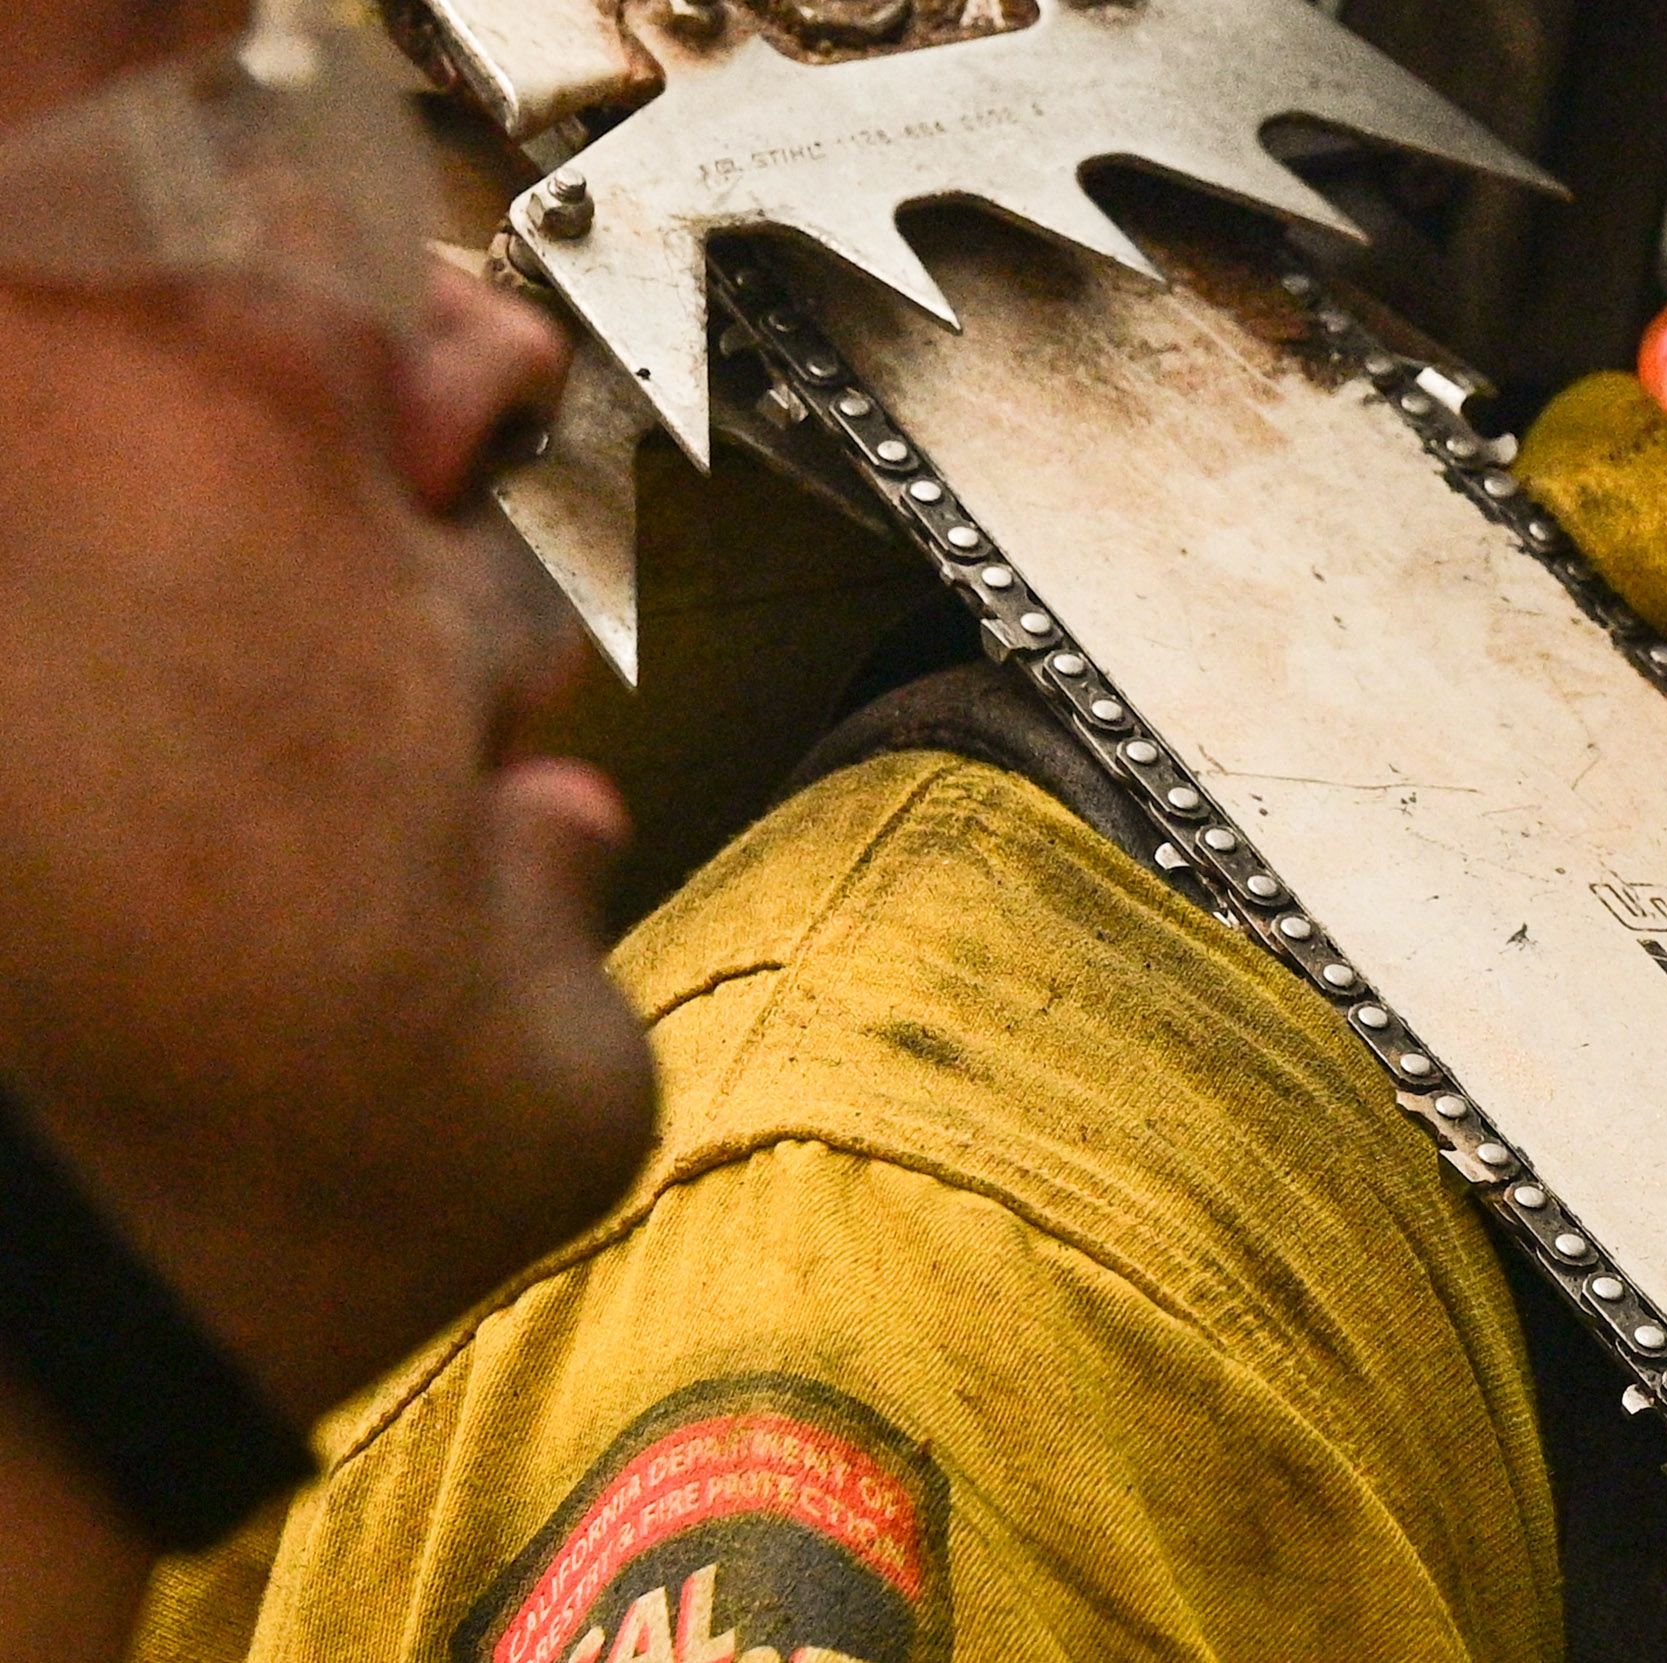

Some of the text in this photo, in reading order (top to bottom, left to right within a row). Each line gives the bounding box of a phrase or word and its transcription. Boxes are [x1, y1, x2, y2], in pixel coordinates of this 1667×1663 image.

[508, 1473, 642, 1663] CALIFORNIA
[615, 1524, 637, 1553] &
[640, 1480, 702, 1536] FIRE
